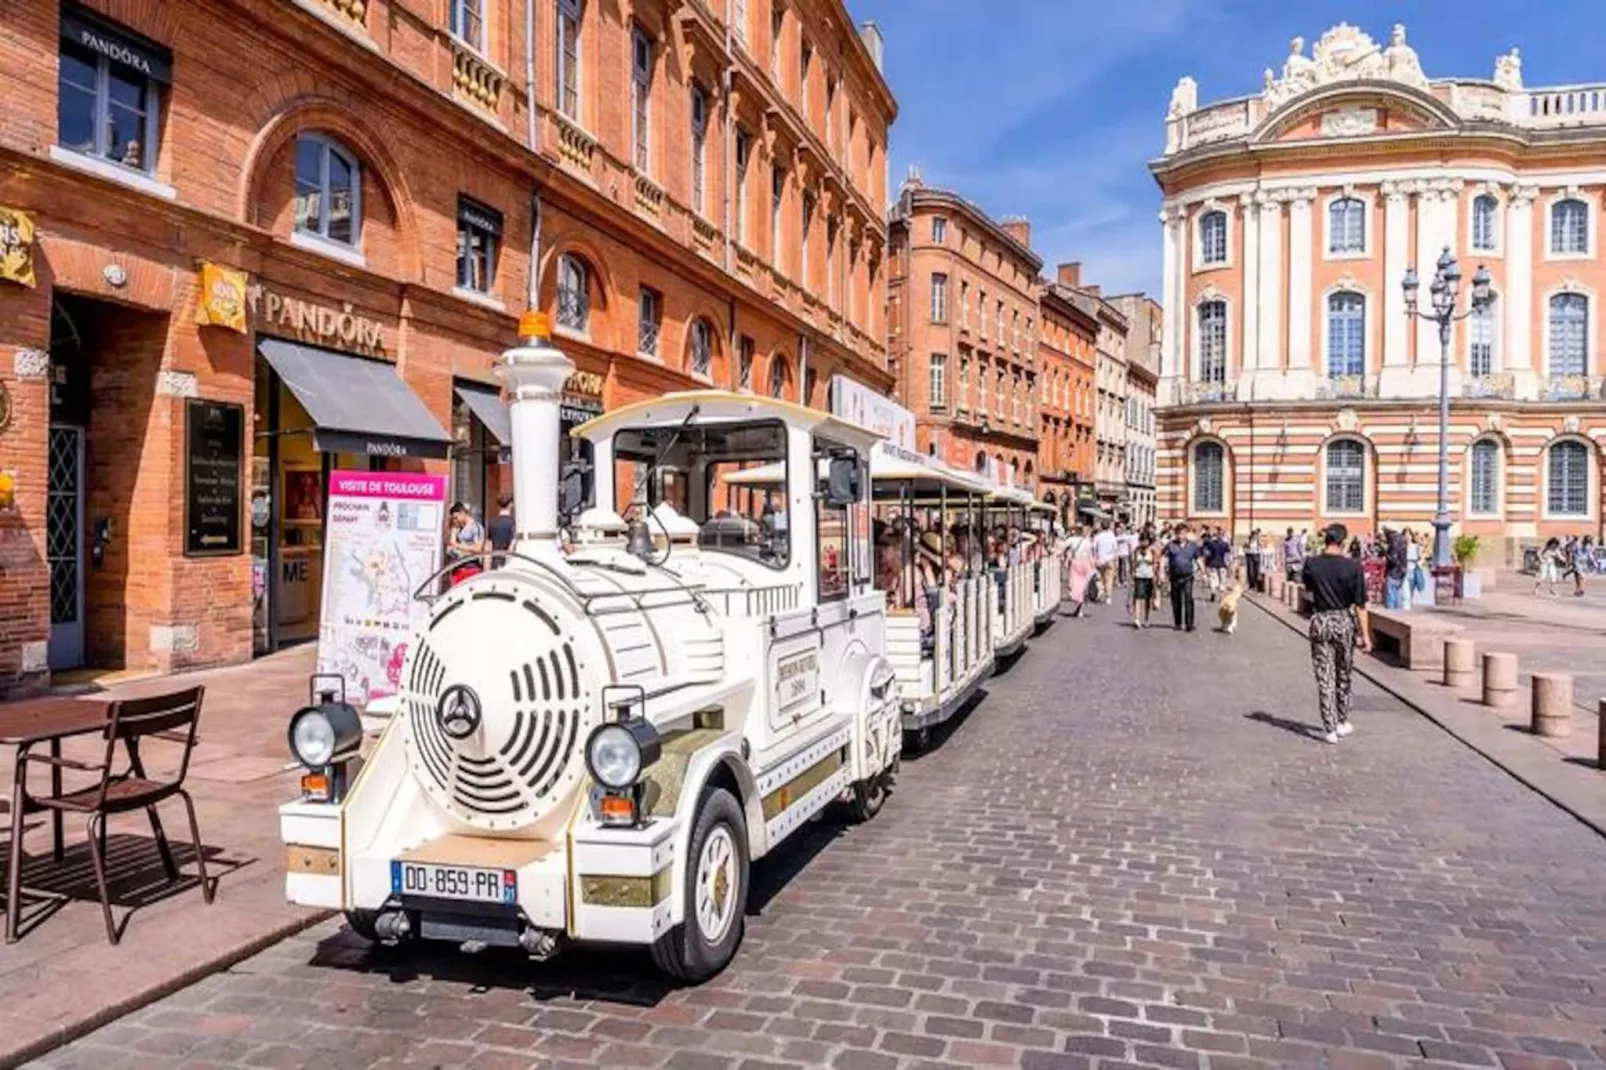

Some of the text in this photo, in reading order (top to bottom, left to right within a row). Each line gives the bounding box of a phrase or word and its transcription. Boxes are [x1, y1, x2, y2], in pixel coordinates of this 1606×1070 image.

[81, 30, 151, 75] PANDORA
[265, 291, 386, 348] PANDORA
[366, 442, 407, 455] PANDORA
[338, 480, 435, 495] VISITE DE TOULOUSE
[283, 562, 309, 583] ME
